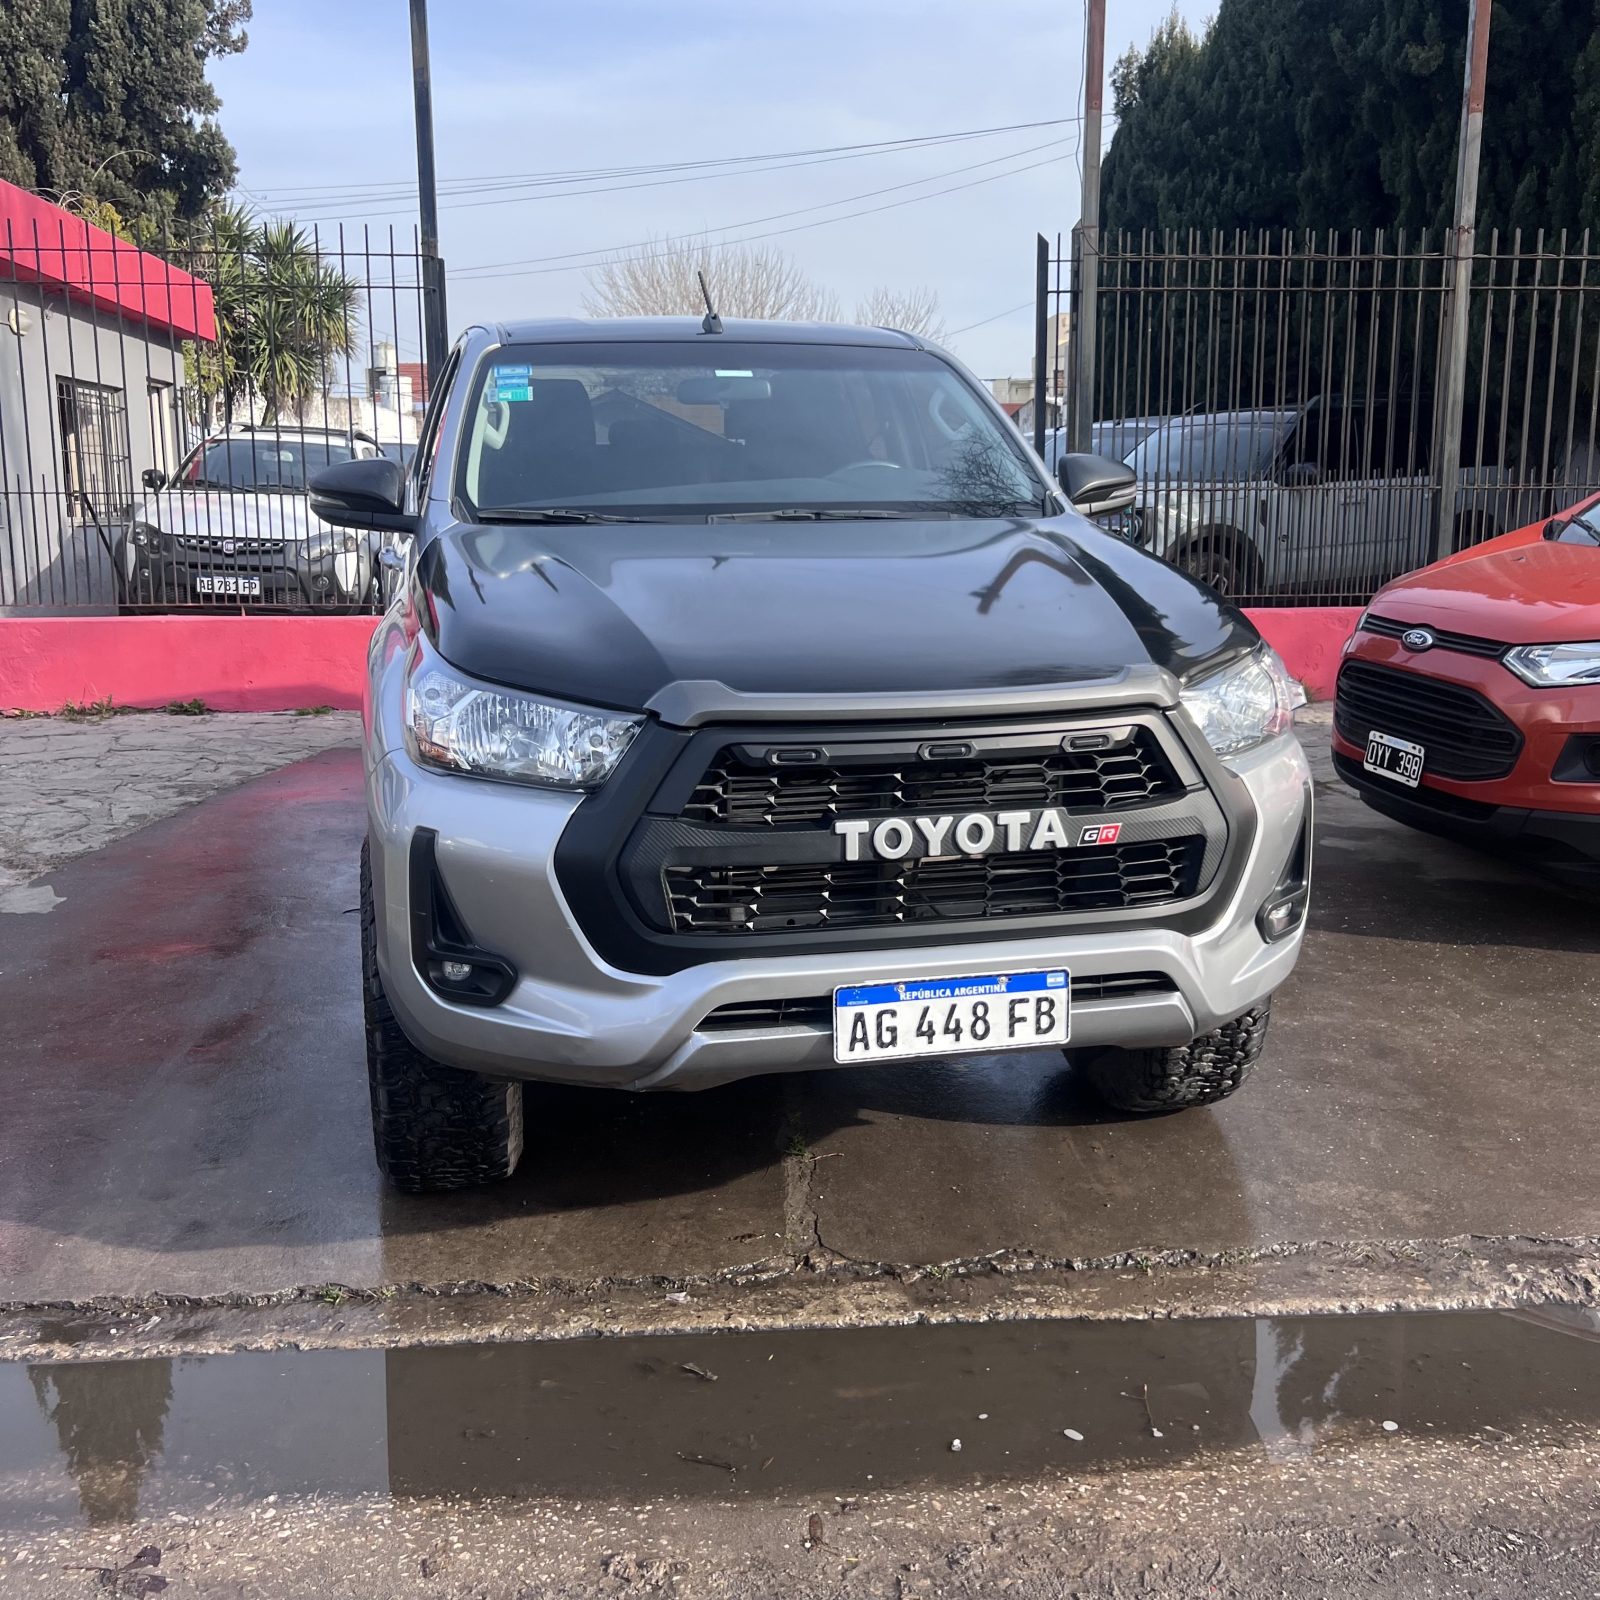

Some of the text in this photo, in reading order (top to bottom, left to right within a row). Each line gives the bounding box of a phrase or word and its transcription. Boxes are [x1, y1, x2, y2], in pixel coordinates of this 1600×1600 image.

[1367, 742, 1392, 768] OYY
[1396, 751, 1420, 779] 398
[834, 809, 1069, 861] TOYOTA
[1083, 828, 1116, 841] GR
[900, 983, 1007, 1001] REPÚBLICA ARGENTINA
[849, 996, 1056, 1052] AG 448 FB
